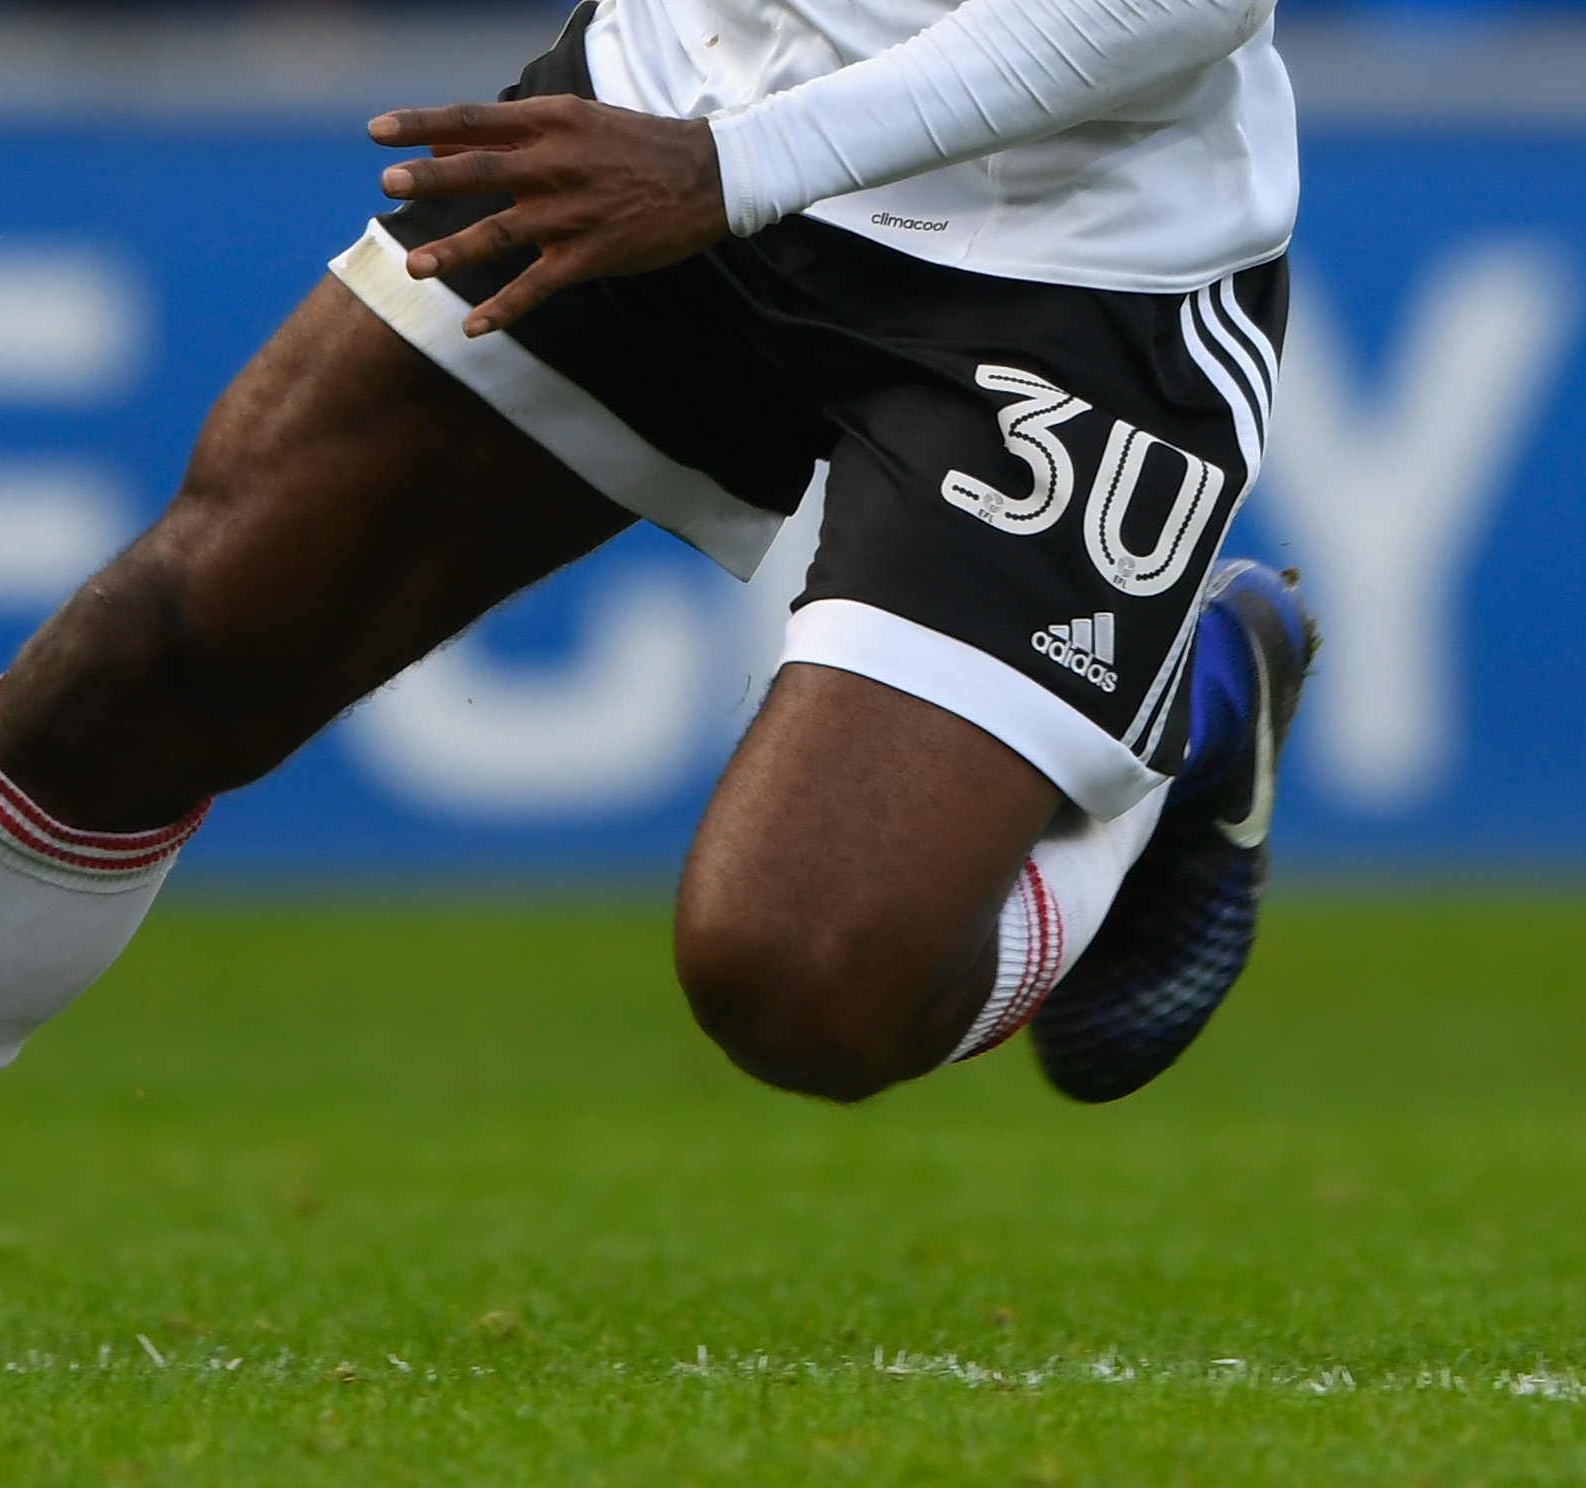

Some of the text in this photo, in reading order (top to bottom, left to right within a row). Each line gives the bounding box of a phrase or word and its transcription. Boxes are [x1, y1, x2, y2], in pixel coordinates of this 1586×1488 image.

[871, 212, 949, 232] climacool
[941, 364, 1225, 597] 30
[978, 508, 994, 523] EFL
[1113, 574, 1127, 589] EFL
[1031, 631, 1118, 692] adidas
